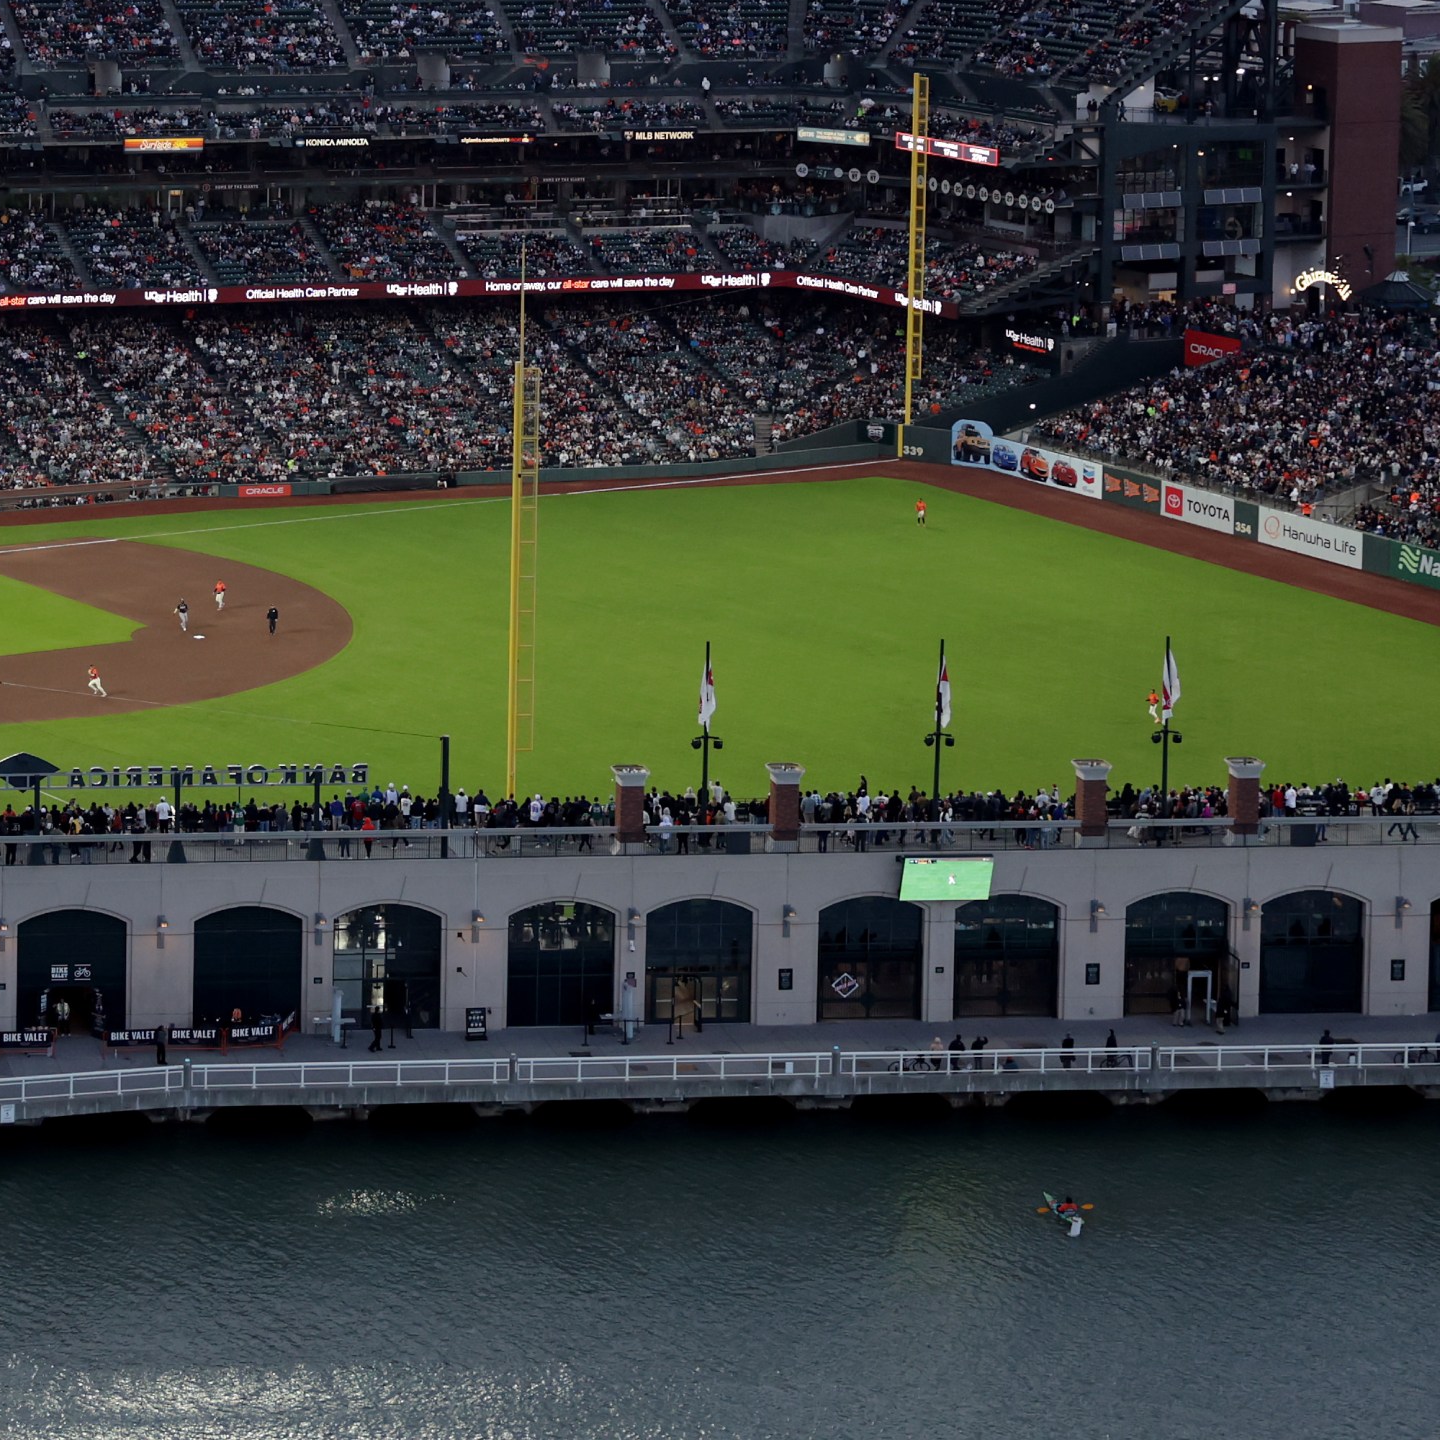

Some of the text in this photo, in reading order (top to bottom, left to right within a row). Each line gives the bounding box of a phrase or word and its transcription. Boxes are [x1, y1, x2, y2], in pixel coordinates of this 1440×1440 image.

[635, 131, 694, 140] MLB NETWORK
[306, 138, 369, 147] KONICA MINOLTA
[486, 281, 511, 291] Home
[523, 282, 546, 292] away,
[548, 281, 562, 289] our
[563, 280, 589, 289] all-star
[591, 279, 609, 289] care
[623, 279, 643, 287] save
[644, 277, 658, 286] the
[659, 277, 675, 287] day
[722, 274, 755, 286] Health
[246, 286, 360, 299] Official Health Care Partner
[408, 283, 442, 295] Health
[796, 275, 878, 299] Official Health Care Partner
[0, 296, 27, 307] all-star
[28, 296, 46, 305] care
[48, 294, 61, 305] will
[62, 295, 82, 304] save
[84, 293, 98, 304] the
[100, 293, 116, 304] day
[167, 290, 202, 302] Health
[1020, 332, 1044, 348] Health
[1190, 343, 1233, 358] ORACL
[903, 445, 924, 456] 339
[246, 487, 284, 495] ORACLE
[1187, 499, 1230, 522] TOYOTA
[1235, 522, 1251, 535] 354
[1283, 525, 1356, 556] Hanwha Life
[51, 966, 68, 974] BIKE
[2, 1032, 48, 1042] BIKE VALET
[111, 1030, 155, 1041] BIKE VALET
[171, 1029, 216, 1039] BIKE VALET
[231, 1026, 274, 1038] BIKE VALET
